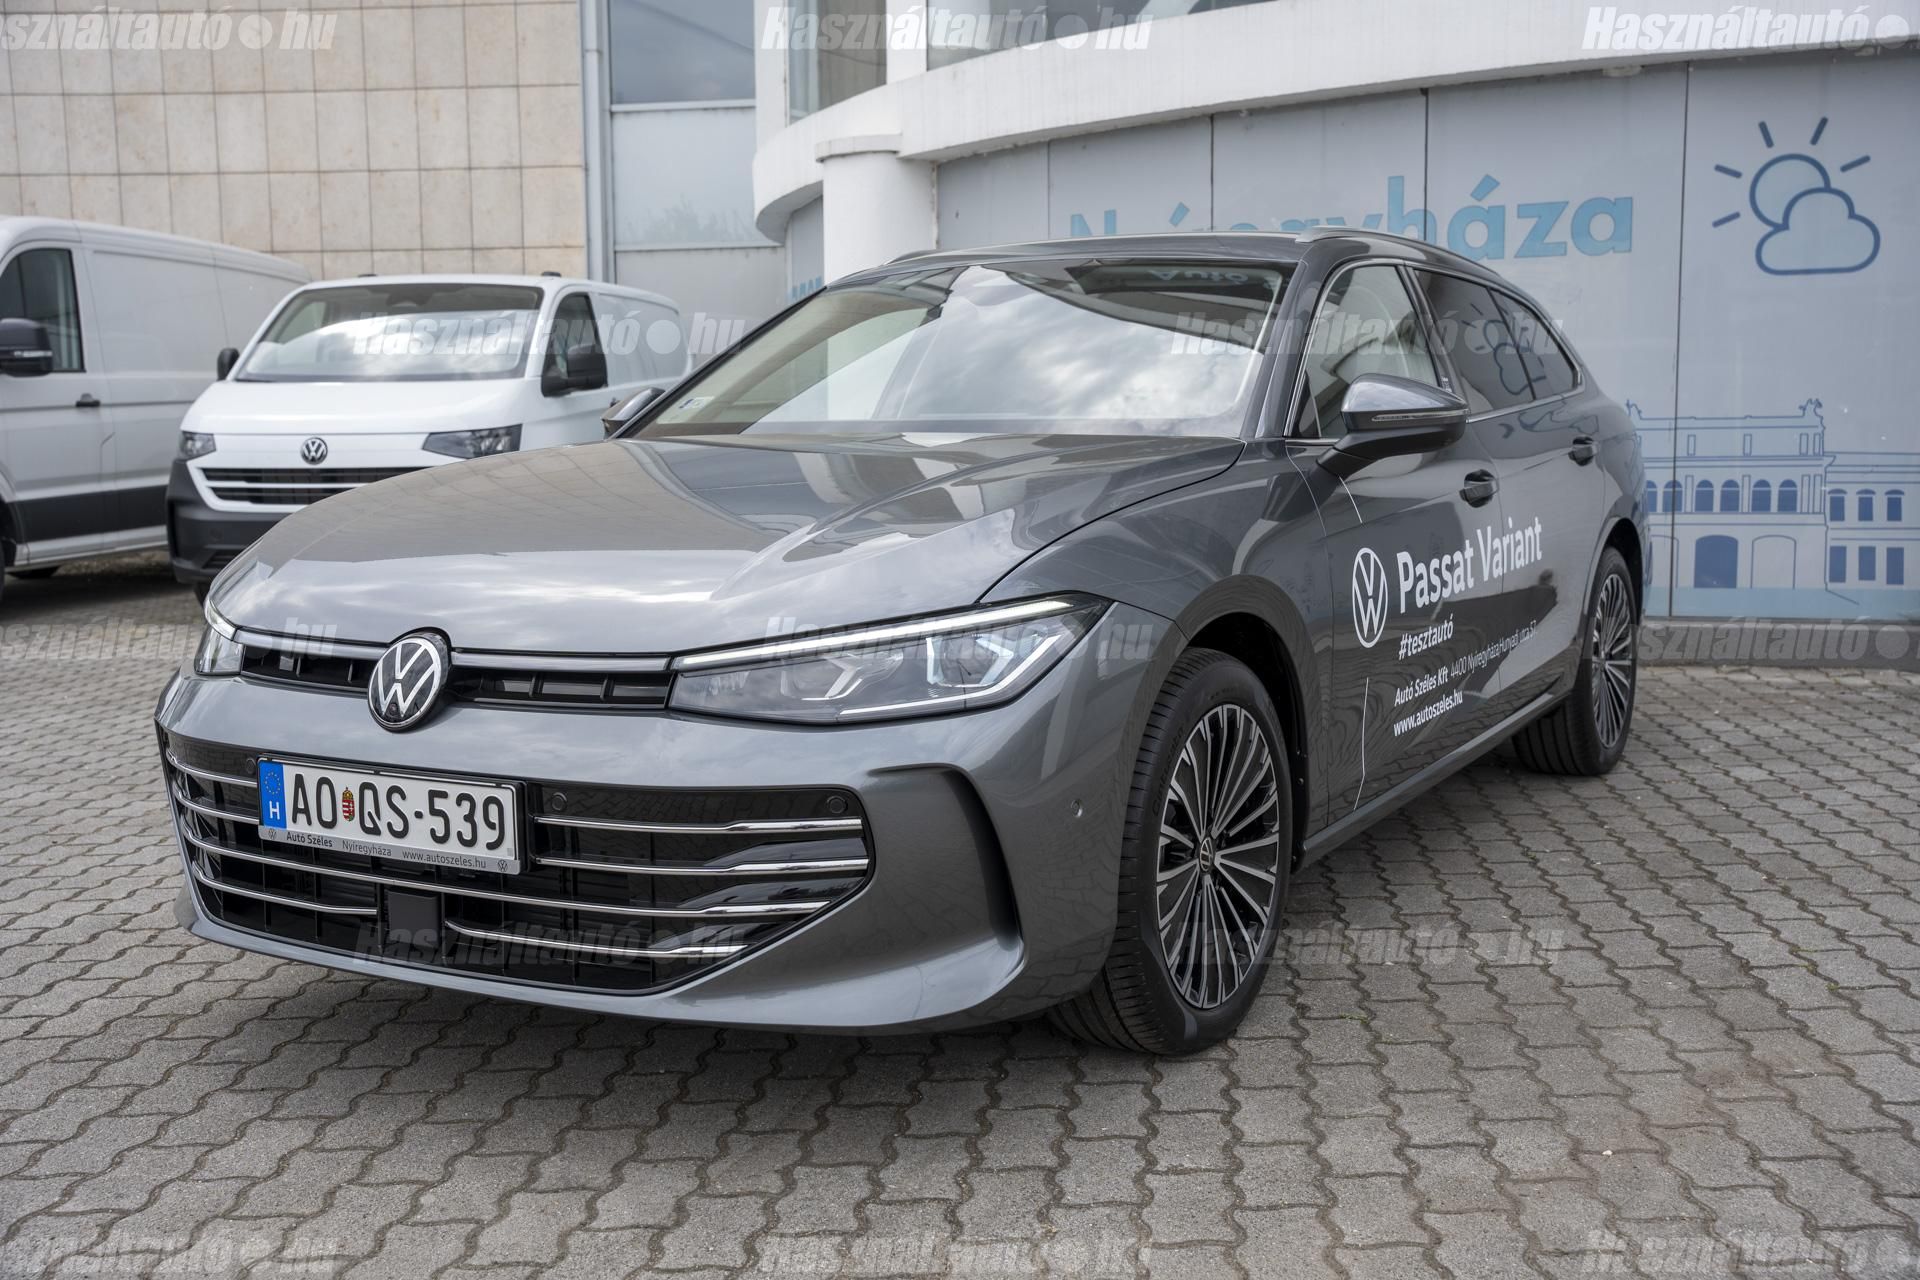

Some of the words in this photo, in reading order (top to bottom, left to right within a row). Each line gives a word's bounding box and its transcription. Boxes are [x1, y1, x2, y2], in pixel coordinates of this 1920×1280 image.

[1396, 539, 1475, 615] Passat
[1476, 516, 1543, 582] Variant
[1398, 613, 1454, 661] #tesztautó
[1395, 681, 1414, 707] Autó
[1414, 672, 1437, 698] Széles
[1437, 665, 1449, 687] Kft
[1450, 656, 1467, 678] 4400
[1393, 690, 1463, 737] www.autoszeles.hu
[269, 800, 280, 820] H
[286, 831, 306, 844] Autó
[306, 834, 333, 849] Széles
[342, 840, 392, 857] Nyíregyháza
[402, 850, 487, 870] www.autoszeles.hu
